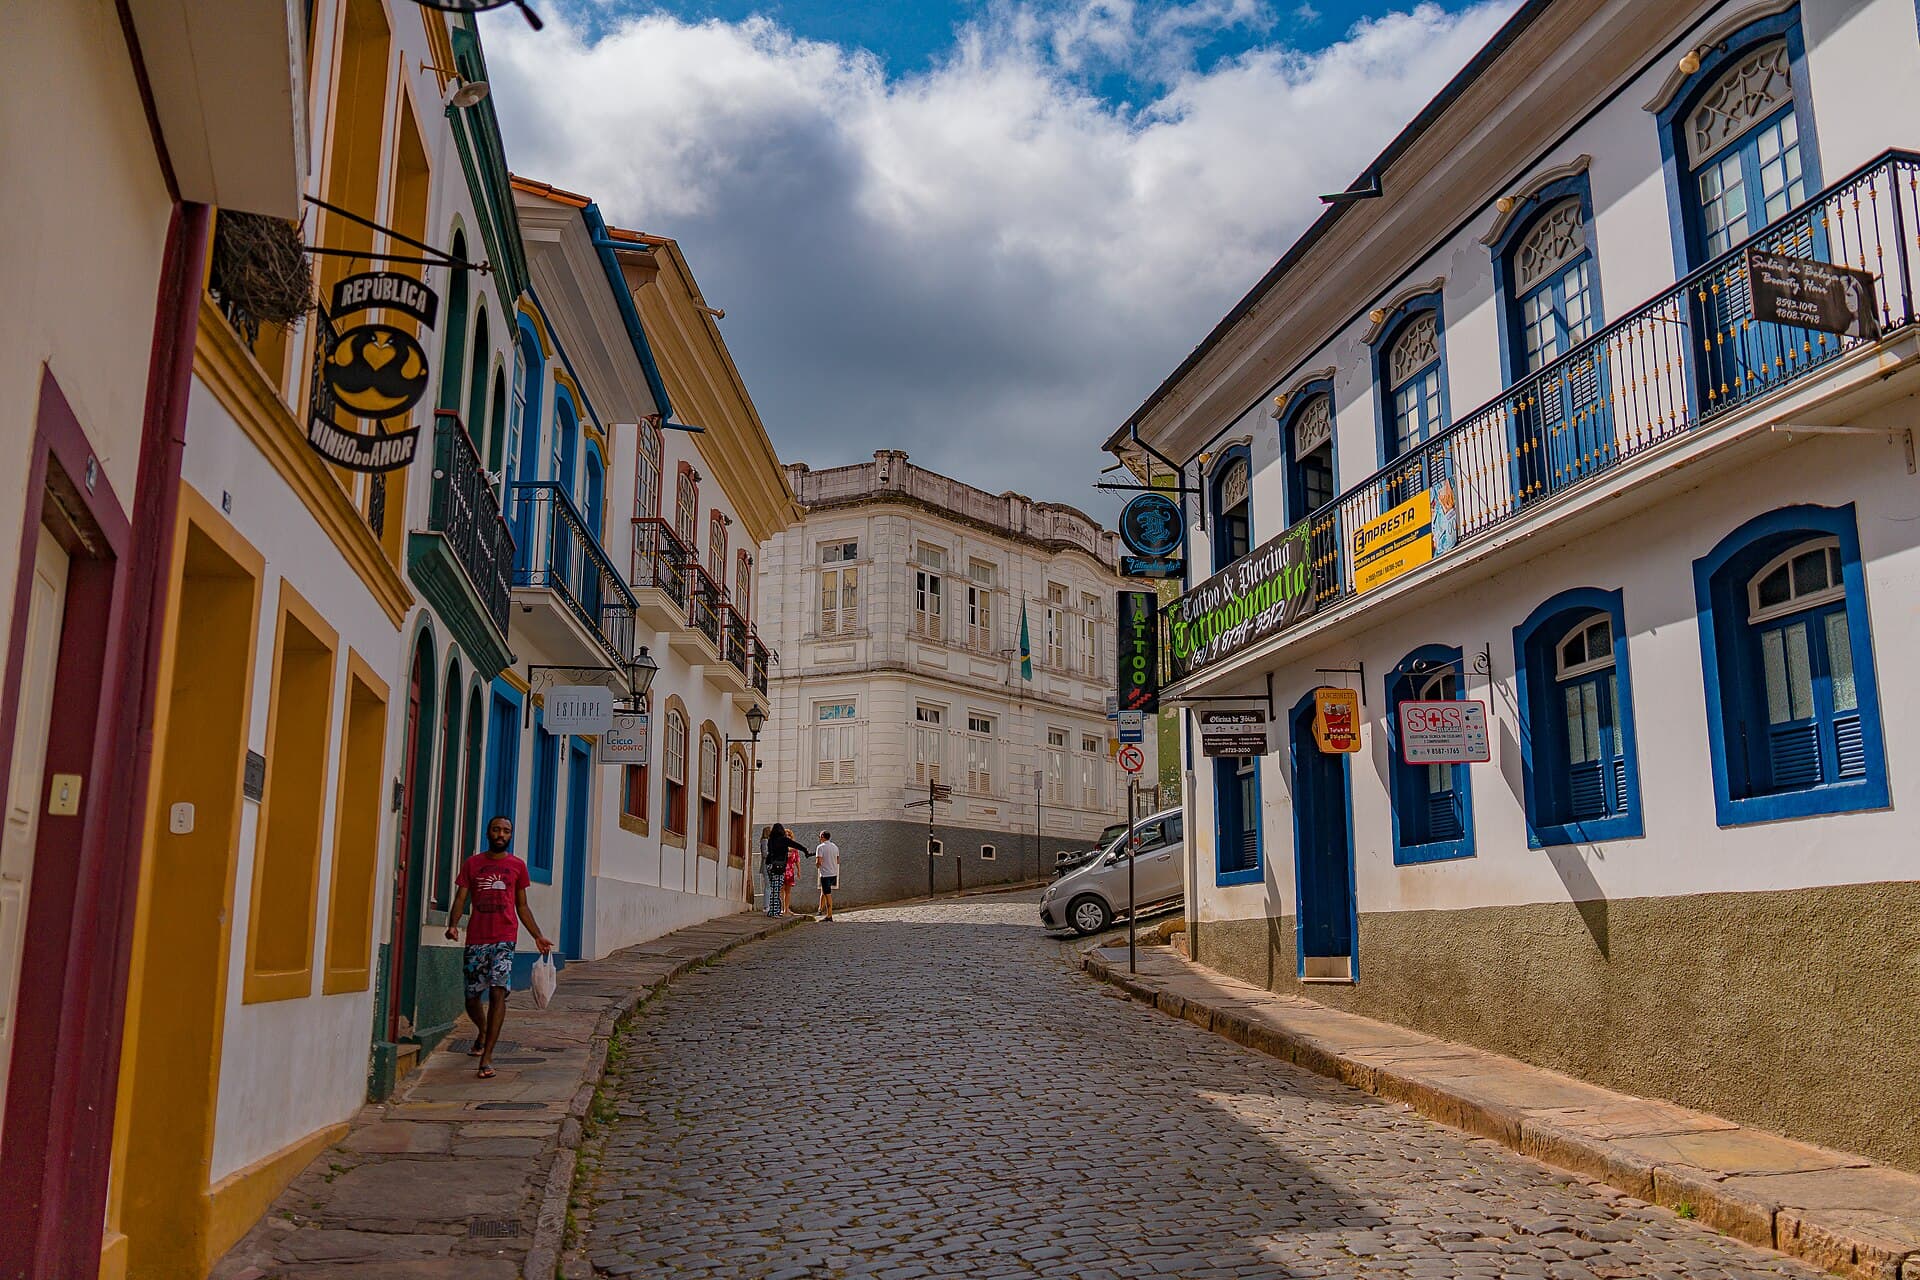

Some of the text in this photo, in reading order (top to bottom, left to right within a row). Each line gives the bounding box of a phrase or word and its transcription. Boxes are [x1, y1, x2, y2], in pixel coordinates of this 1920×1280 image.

[340, 272, 428, 314] REPÚBLICA
[309, 416, 357, 463] NINHO
[368, 435, 414, 467] AMOR
[1354, 507, 1415, 556] EMPRESTA
[1182, 542, 1291, 622] Tattoo & Piercing
[1131, 592, 1146, 686] TATTOO
[1407, 707, 1462, 732] SOS
[611, 744, 644, 752] ODONTO
